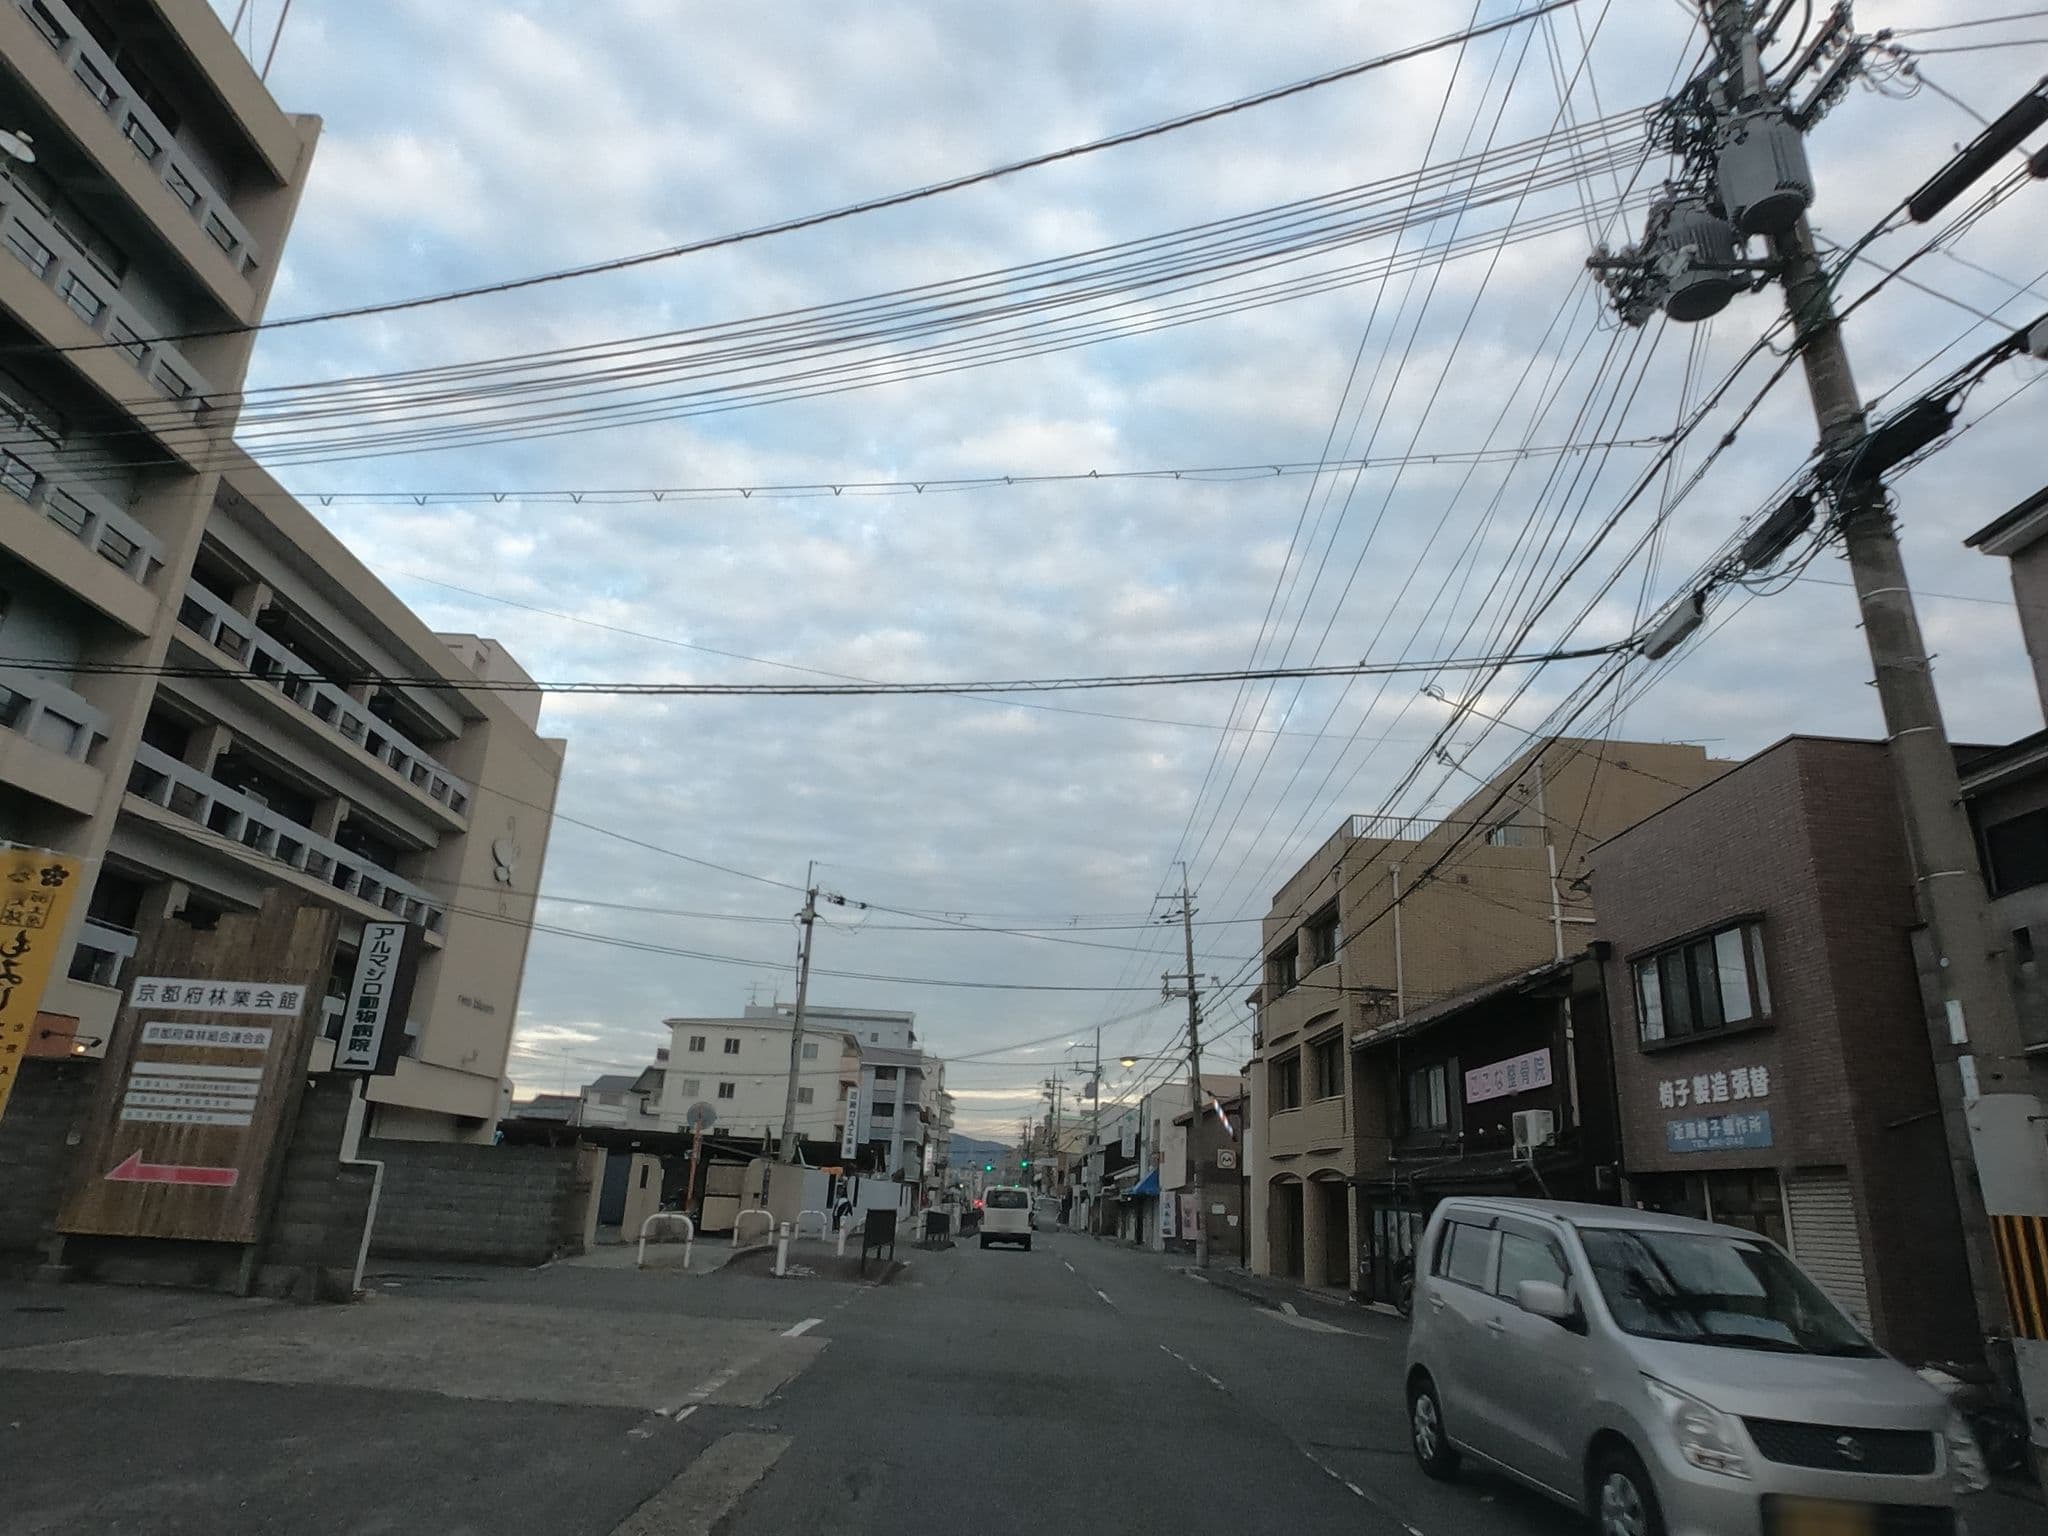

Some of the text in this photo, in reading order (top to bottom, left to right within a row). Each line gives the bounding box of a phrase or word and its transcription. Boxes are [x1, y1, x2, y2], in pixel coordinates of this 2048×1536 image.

[136, 984, 299, 1010] 京都府林業会館
